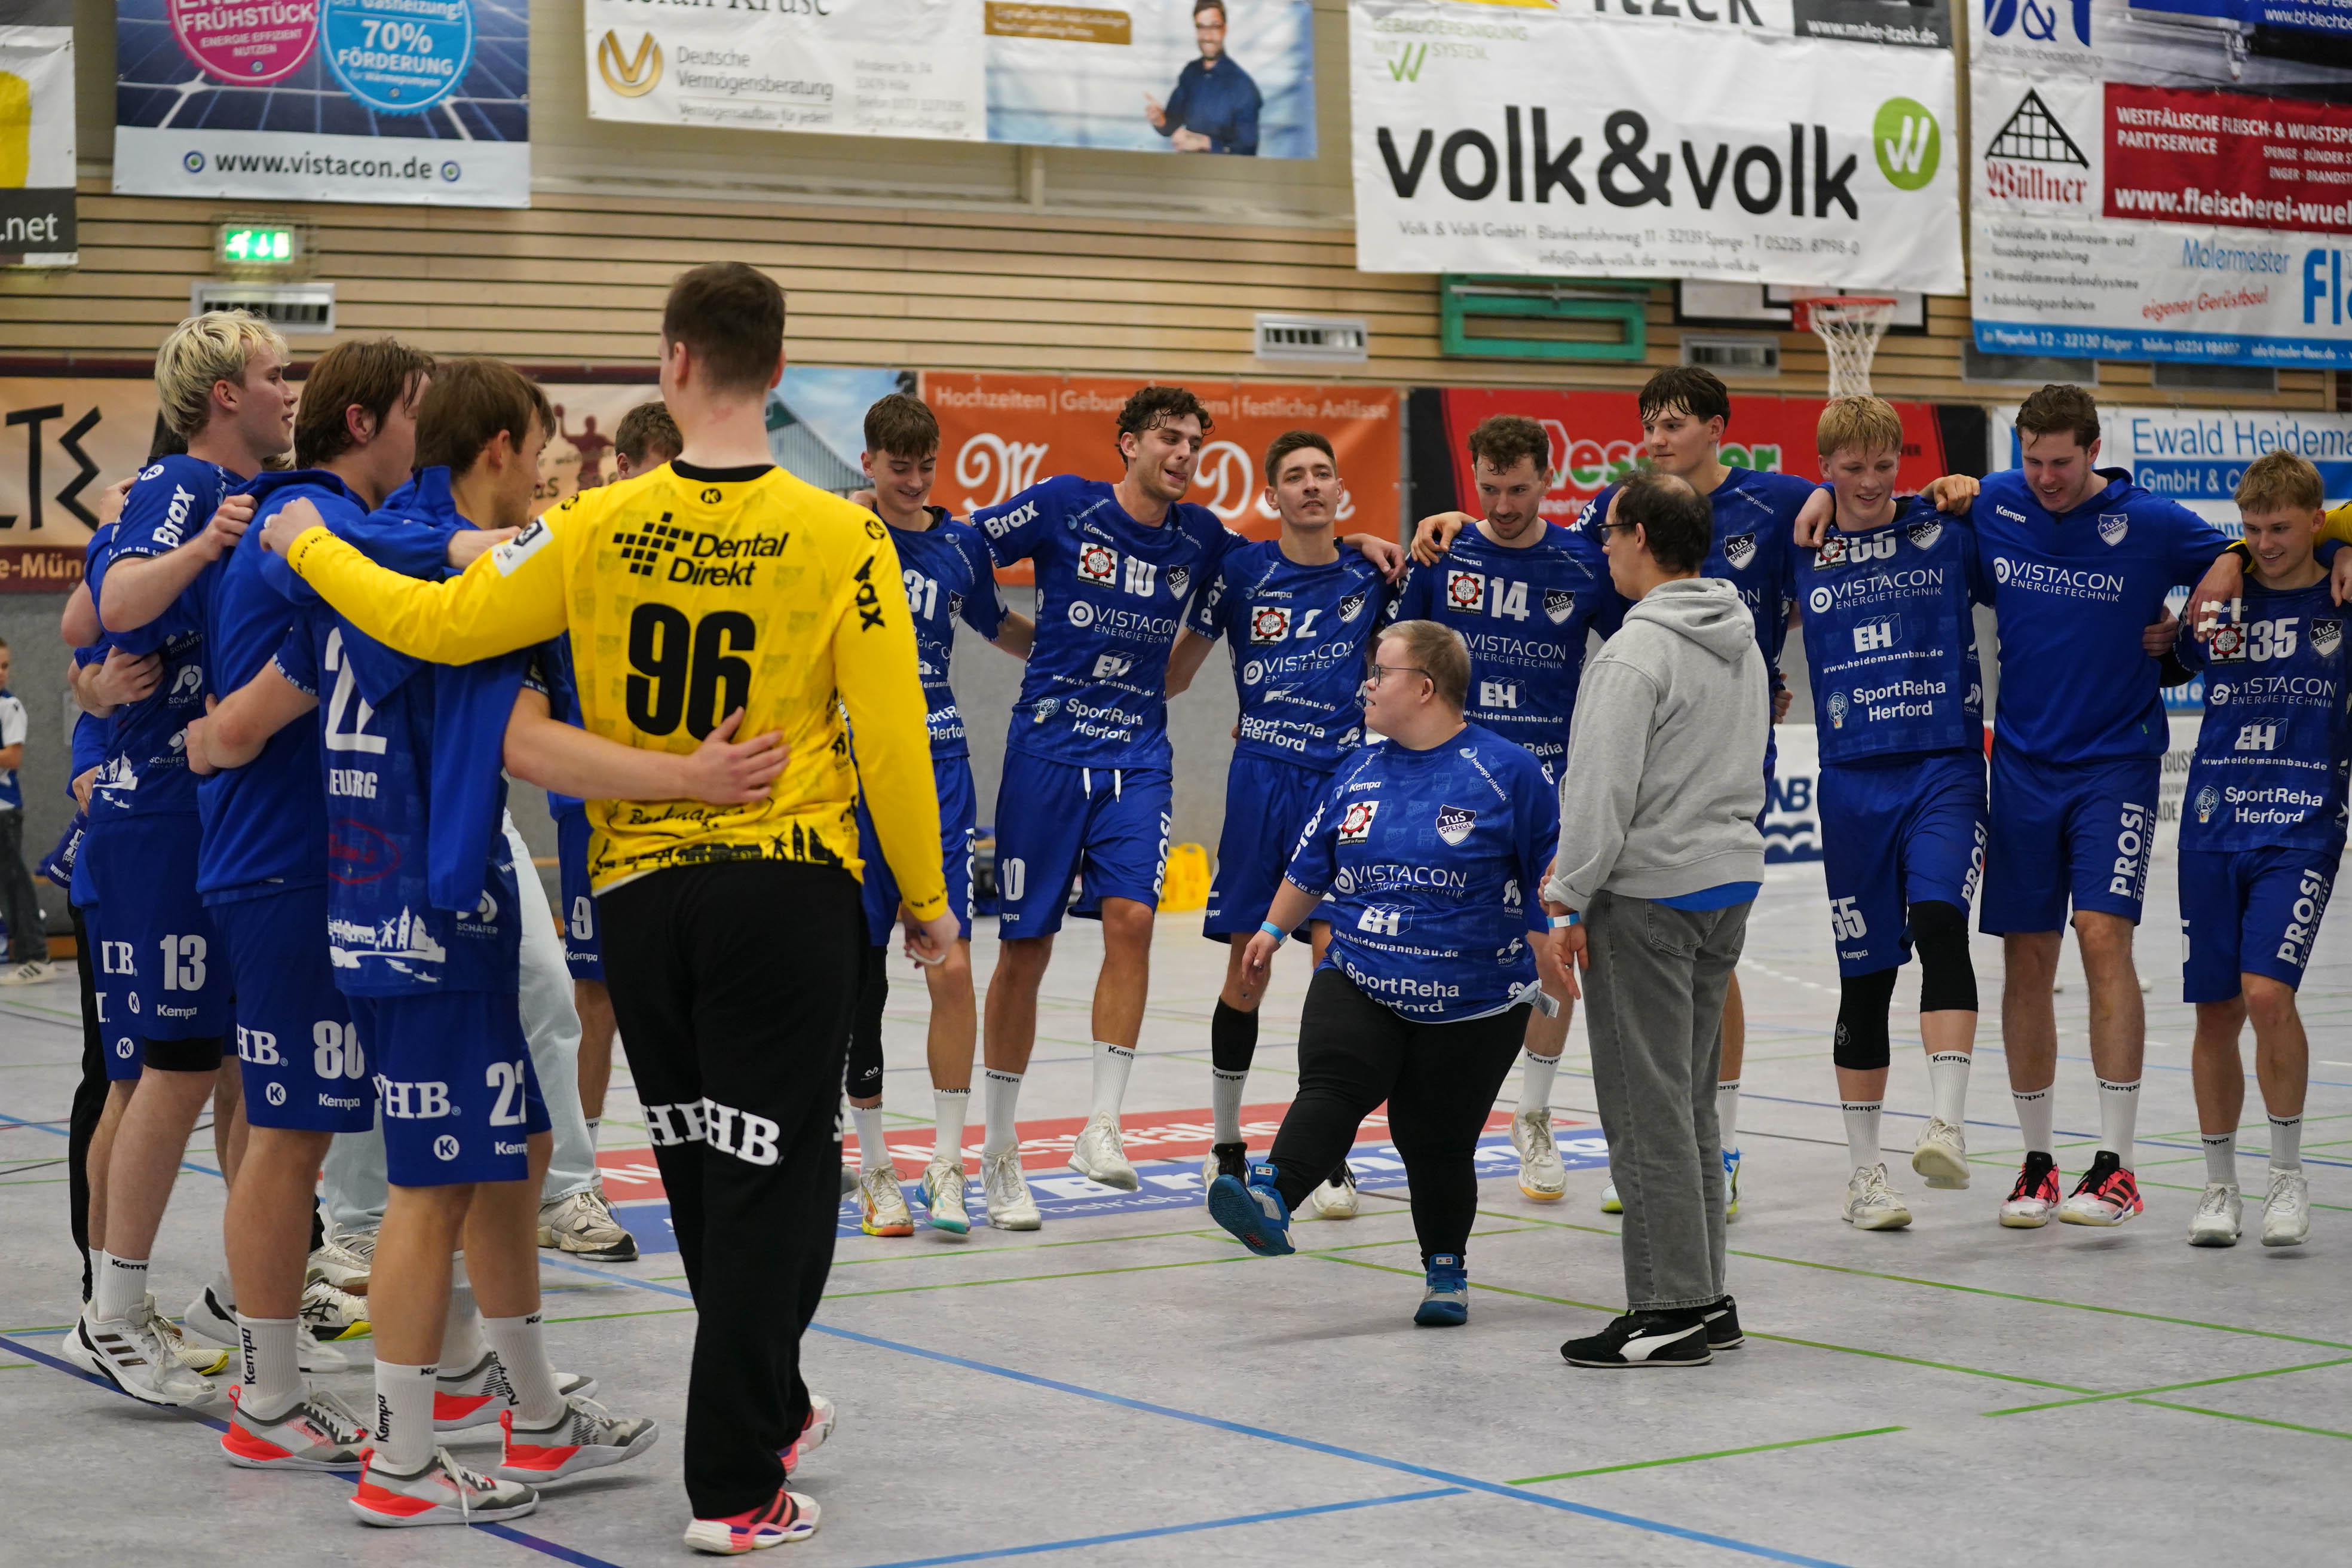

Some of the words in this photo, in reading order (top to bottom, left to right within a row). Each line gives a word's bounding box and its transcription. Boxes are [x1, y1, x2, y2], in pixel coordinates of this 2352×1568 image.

[180, 2, 315, 32] FRÜHSTÜCK
[362, 20, 433, 53] 70%
[338, 48, 454, 75] FÖRDERUNG
[676, 45, 750, 68] Deutsche
[676, 69, 834, 102] Vermögensberatung
[2116, 106, 2219, 133] WESTFÄLISCHE
[2274, 121, 2285, 139] &
[2117, 129, 2218, 155] PARTYSERVICE
[216, 151, 433, 180] www.vistacon.de
[1377, 105, 1859, 220] volk&volk
[2182, 238, 2290, 274] Malermeister
[2142, 299, 2194, 323] eigener
[935, 385, 1047, 409] Hochzeiten
[1242, 393, 1317, 418] festliche
[1319, 396, 1390, 420] Anlässe
[2132, 418, 2223, 456] Ewald
[2139, 466, 2200, 492] GmbH
[2206, 468, 2220, 492] &
[151, 483, 196, 549] Brax
[984, 500, 1040, 540] Brax
[1995, 504, 2026, 523] Kempa
[2102, 517, 2120, 531] TuS
[2103, 522, 2126, 538] SPENGE
[691, 532, 789, 559] Dental
[1728, 537, 1748, 553] TuS
[1729, 545, 1756, 565] SPENGE
[667, 557, 757, 587] Direkt
[1123, 555, 1158, 598] 10
[1169, 569, 1186, 583] TuS
[1171, 577, 1189, 593] SPENGE
[1832, 568, 1943, 599] VISTACON
[2011, 559, 2124, 593] VISTACON
[904, 568, 939, 622] 31
[1257, 589, 1293, 600] Kempa
[1490, 576, 1530, 622] 14
[1546, 593, 1567, 606] TuS
[1836, 586, 1942, 610] ENERGIETECHNIK
[2011, 578, 2120, 602] ENERGIETECHNIK
[1342, 596, 1360, 612] TuS
[1546, 598, 1575, 616] SPENGE
[1853, 620, 1893, 653] EH
[2250, 617, 2299, 662] 35
[2314, 621, 2335, 636] TuS
[2315, 630, 2341, 648] SPENGE
[1467, 634, 1566, 660] VISTACON
[626, 601, 757, 742] 96
[1469, 651, 1564, 670] ENERGIETECHNIK
[1823, 648, 1944, 675] www.heidemannbau.de
[1480, 682, 1517, 709] EH
[1853, 679, 1946, 706] SportReha
[1869, 700, 1933, 722] Herford
[1348, 780, 1382, 793] Kempa
[1471, 757, 1491, 779] hapego
[1488, 777, 1508, 802] plastics
[2224, 786, 2323, 807] SportReha
[1441, 821, 1472, 835] SPENGE
[1442, 810, 1467, 825] TuS
[2235, 807, 2305, 824] Herford
[1961, 821, 1988, 904] PROSI
[2110, 802, 2145, 898] PROSI
[2137, 808, 2156, 904] SICHERHEIT
[1351, 863, 1467, 889] VISTACON
[571, 896, 594, 940] 9
[1830, 896, 1867, 942] 55
[2277, 868, 2323, 966] PROSI
[160, 934, 207, 991] 13
[566, 951, 598, 962] Kempa
[1841, 949, 1869, 961] Kempa
[1346, 961, 1460, 998] SportReha
[157, 1003, 198, 1020] Kempa
[313, 1019, 365, 1080] 80
[1933, 1054, 1971, 1065] Kempa
[986, 1070, 1019, 1083] Kempa
[2100, 1080, 2140, 1092] Kempa
[318, 1092, 360, 1110] Kempa
[1842, 1103, 1881, 1112] Kempa
[495, 1140, 528, 1156] Kemp
[244, 1327, 257, 1386] Kempa
[375, 1393, 390, 1443] Kempa
